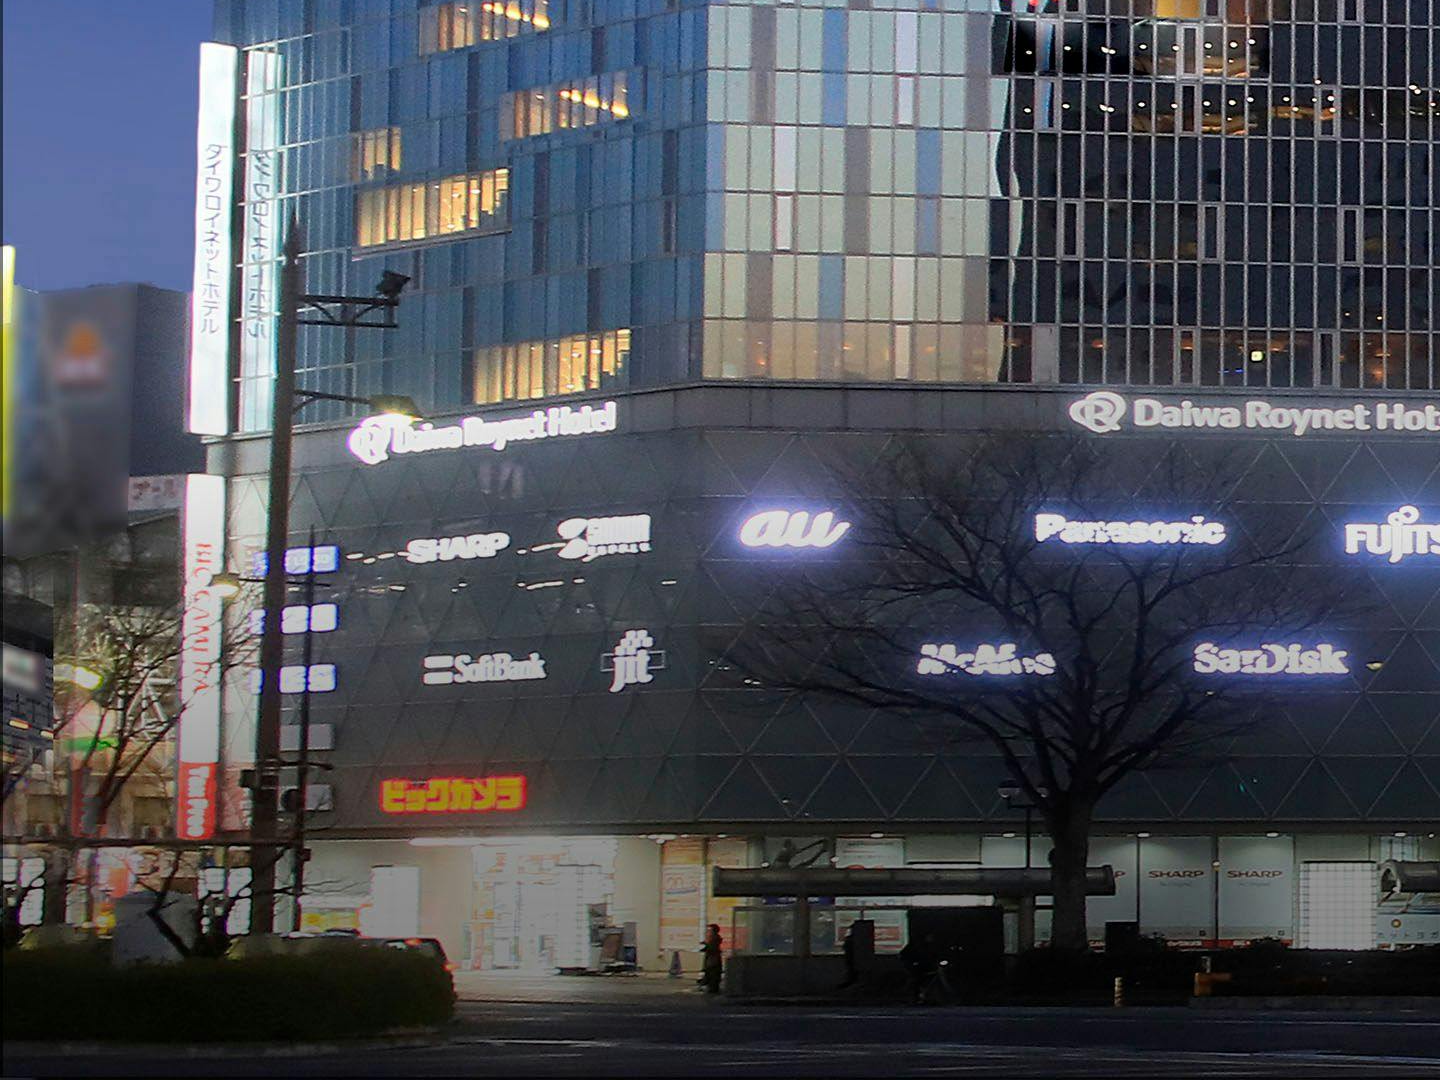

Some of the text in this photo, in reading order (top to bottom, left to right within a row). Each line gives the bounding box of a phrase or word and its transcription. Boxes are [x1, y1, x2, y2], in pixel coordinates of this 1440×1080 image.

[200, 143, 224, 335] ダイワロイネットホテル
[1133, 398, 1242, 428] Daiwa
[1245, 400, 1372, 436] Roynet
[740, 510, 850, 547] au
[1035, 515, 1226, 545] Panasonic
[406, 532, 510, 564] SHARP
[454, 652, 547, 683] SoftBank
[1194, 642, 1349, 676] SanDisk
[380, 776, 527, 812] ビックカメラ
[1149, 870, 1204, 879] SHARP
[1227, 870, 1283, 879] SHARP
